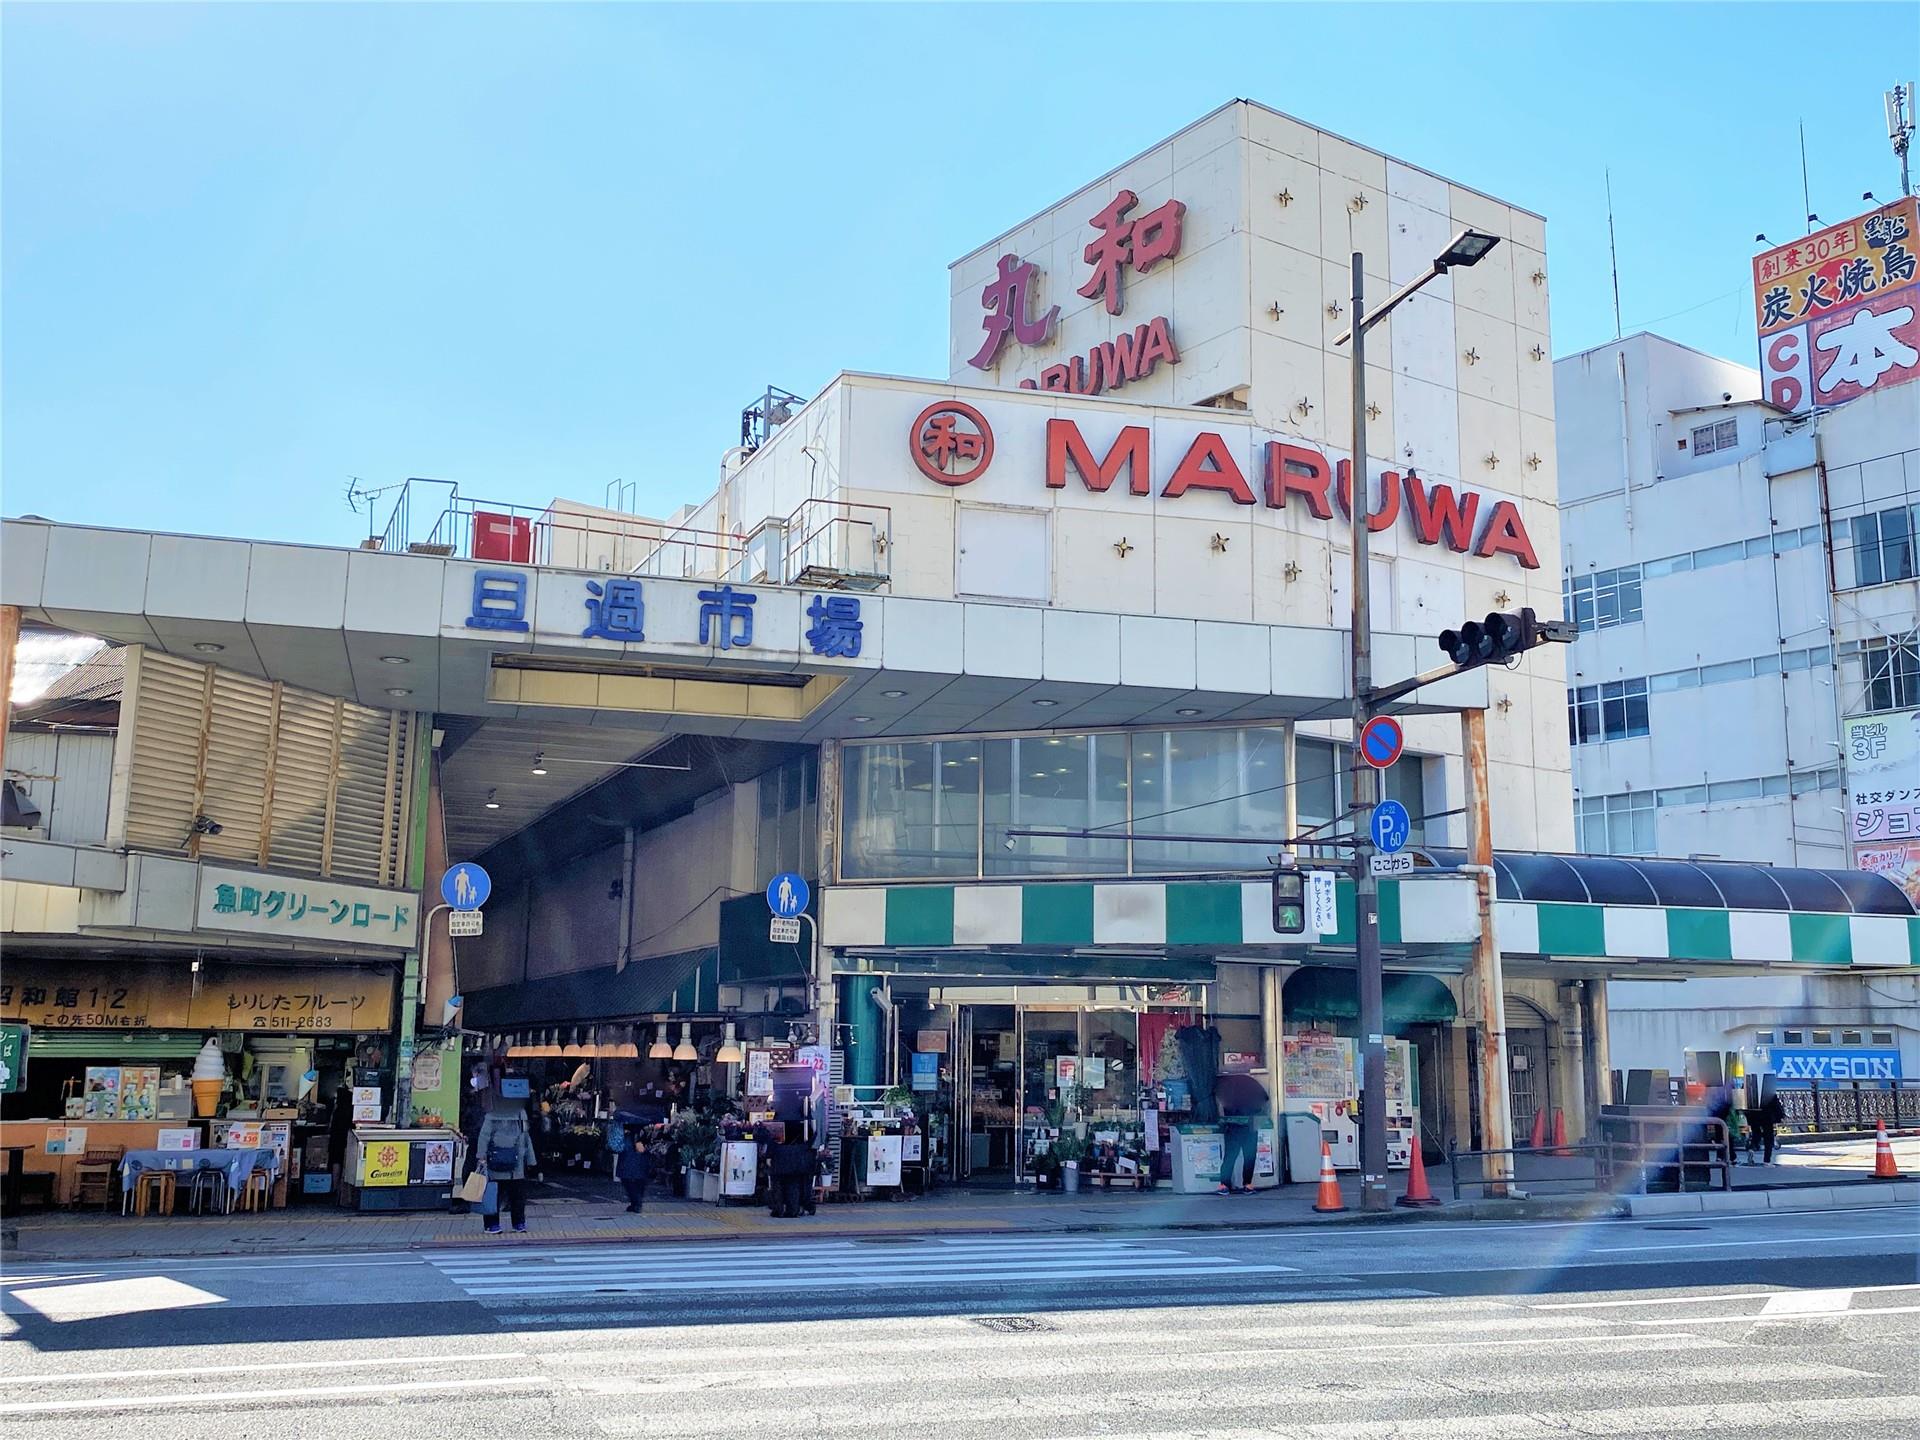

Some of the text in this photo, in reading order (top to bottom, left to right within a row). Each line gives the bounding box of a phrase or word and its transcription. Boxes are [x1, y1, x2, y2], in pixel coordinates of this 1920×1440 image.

[1761, 230, 1855, 281] 創業30年
[968, 189, 1188, 372] 丸和
[1760, 244, 1917, 328] 炭火焼鳥
[1815, 305, 1919, 393] 本
[1768, 334, 1803, 411] CD
[919, 411, 987, 473] 和
[1046, 418, 1541, 570] MARUWA
[464, 568, 863, 658] 旦過市場
[1851, 723, 1888, 738] 当ビル
[1852, 736, 1887, 761] 3F
[1379, 815, 1394, 848] P
[1855, 806, 1920, 837] ジョ
[1374, 857, 1410, 871] ここから
[213, 883, 409, 932] 魚町グリーンロード
[43, 1014, 147, 1027] この先50M右折
[227, 993, 366, 1011] もりしたフルーツ
[271, 1016, 332, 1028] 511-2683
[1777, 1056, 1896, 1079] AWSON
